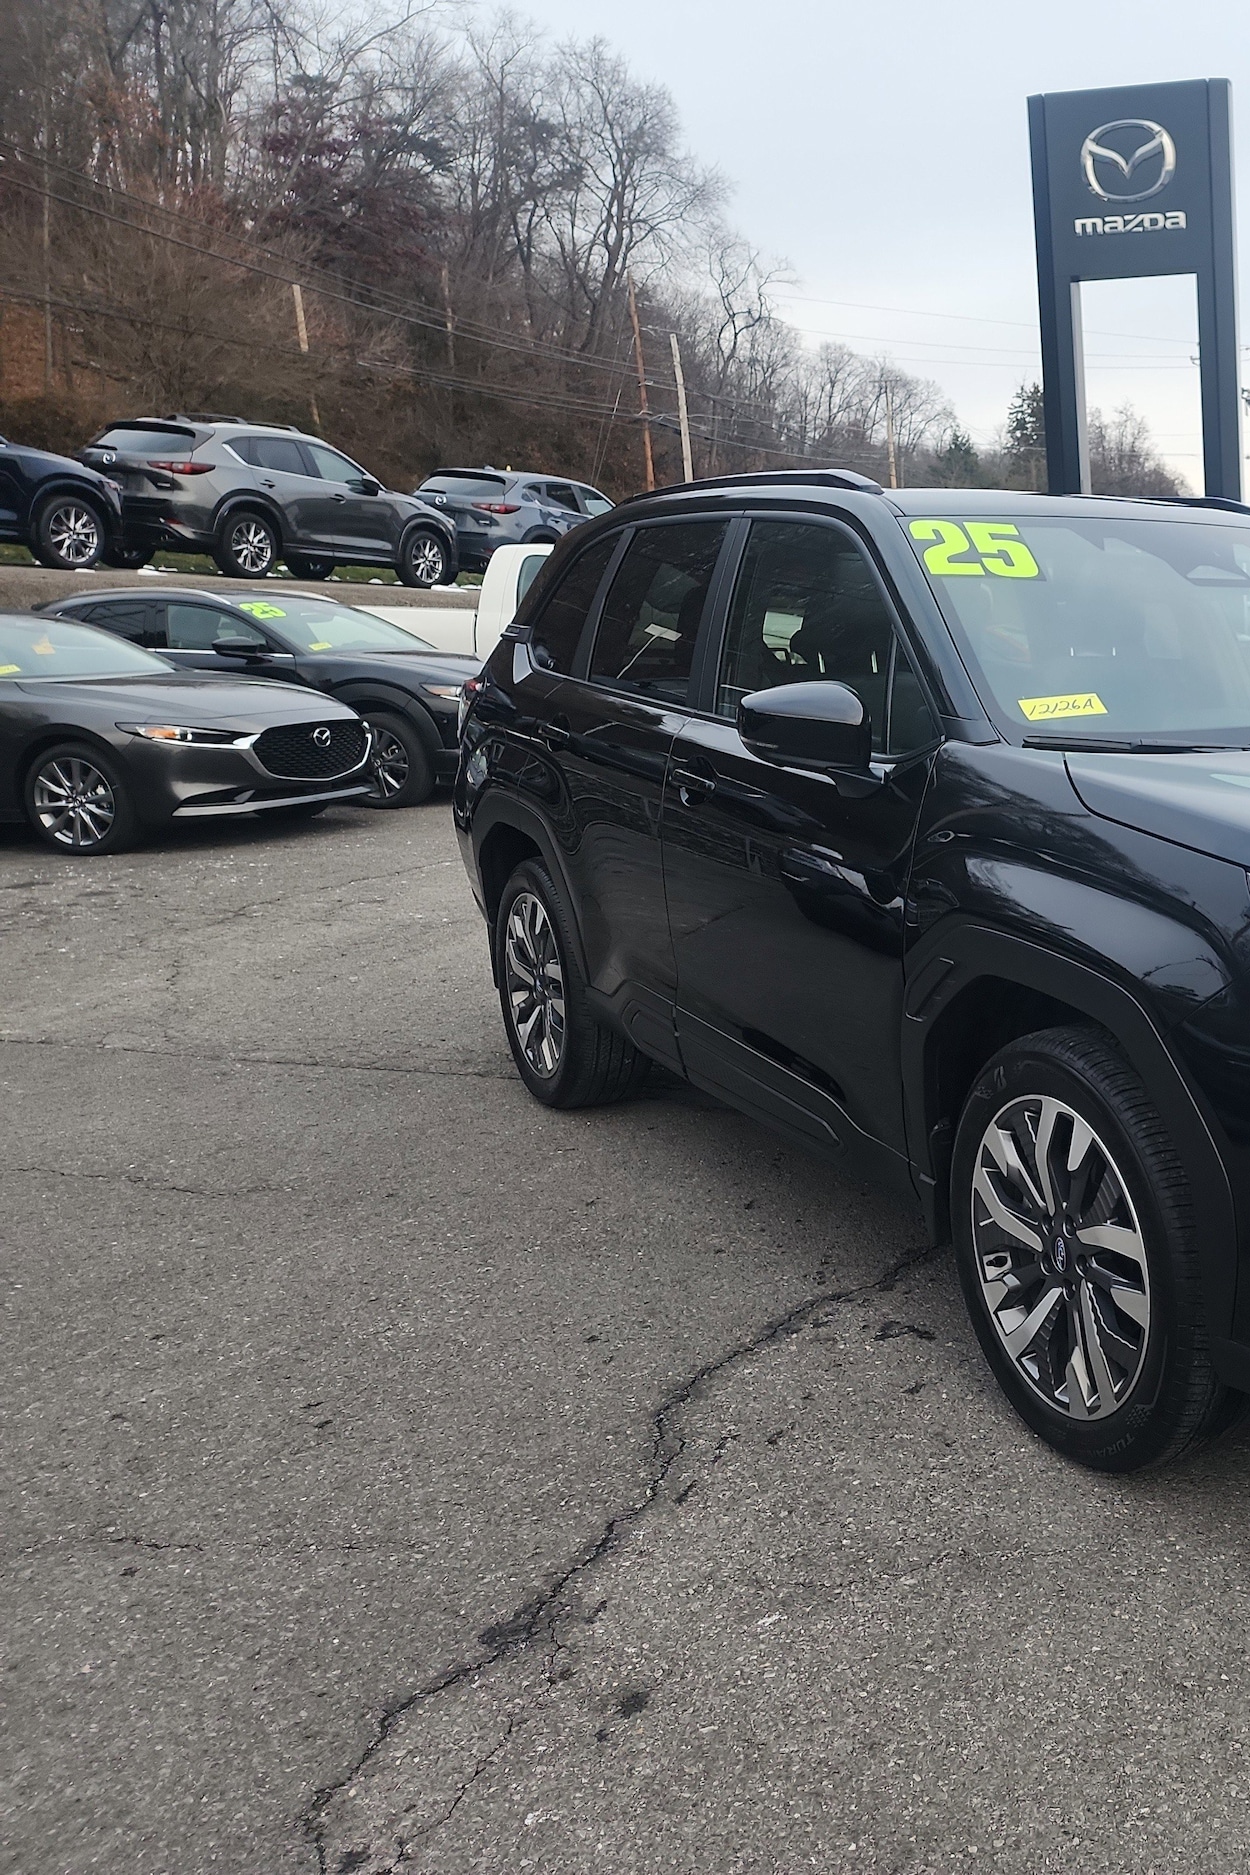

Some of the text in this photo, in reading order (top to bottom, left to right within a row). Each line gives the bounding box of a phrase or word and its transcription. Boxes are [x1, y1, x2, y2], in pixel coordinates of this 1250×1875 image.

[1073, 210, 1188, 237] mazda
[908, 519, 1040, 579] 25
[239, 602, 287, 619] 25
